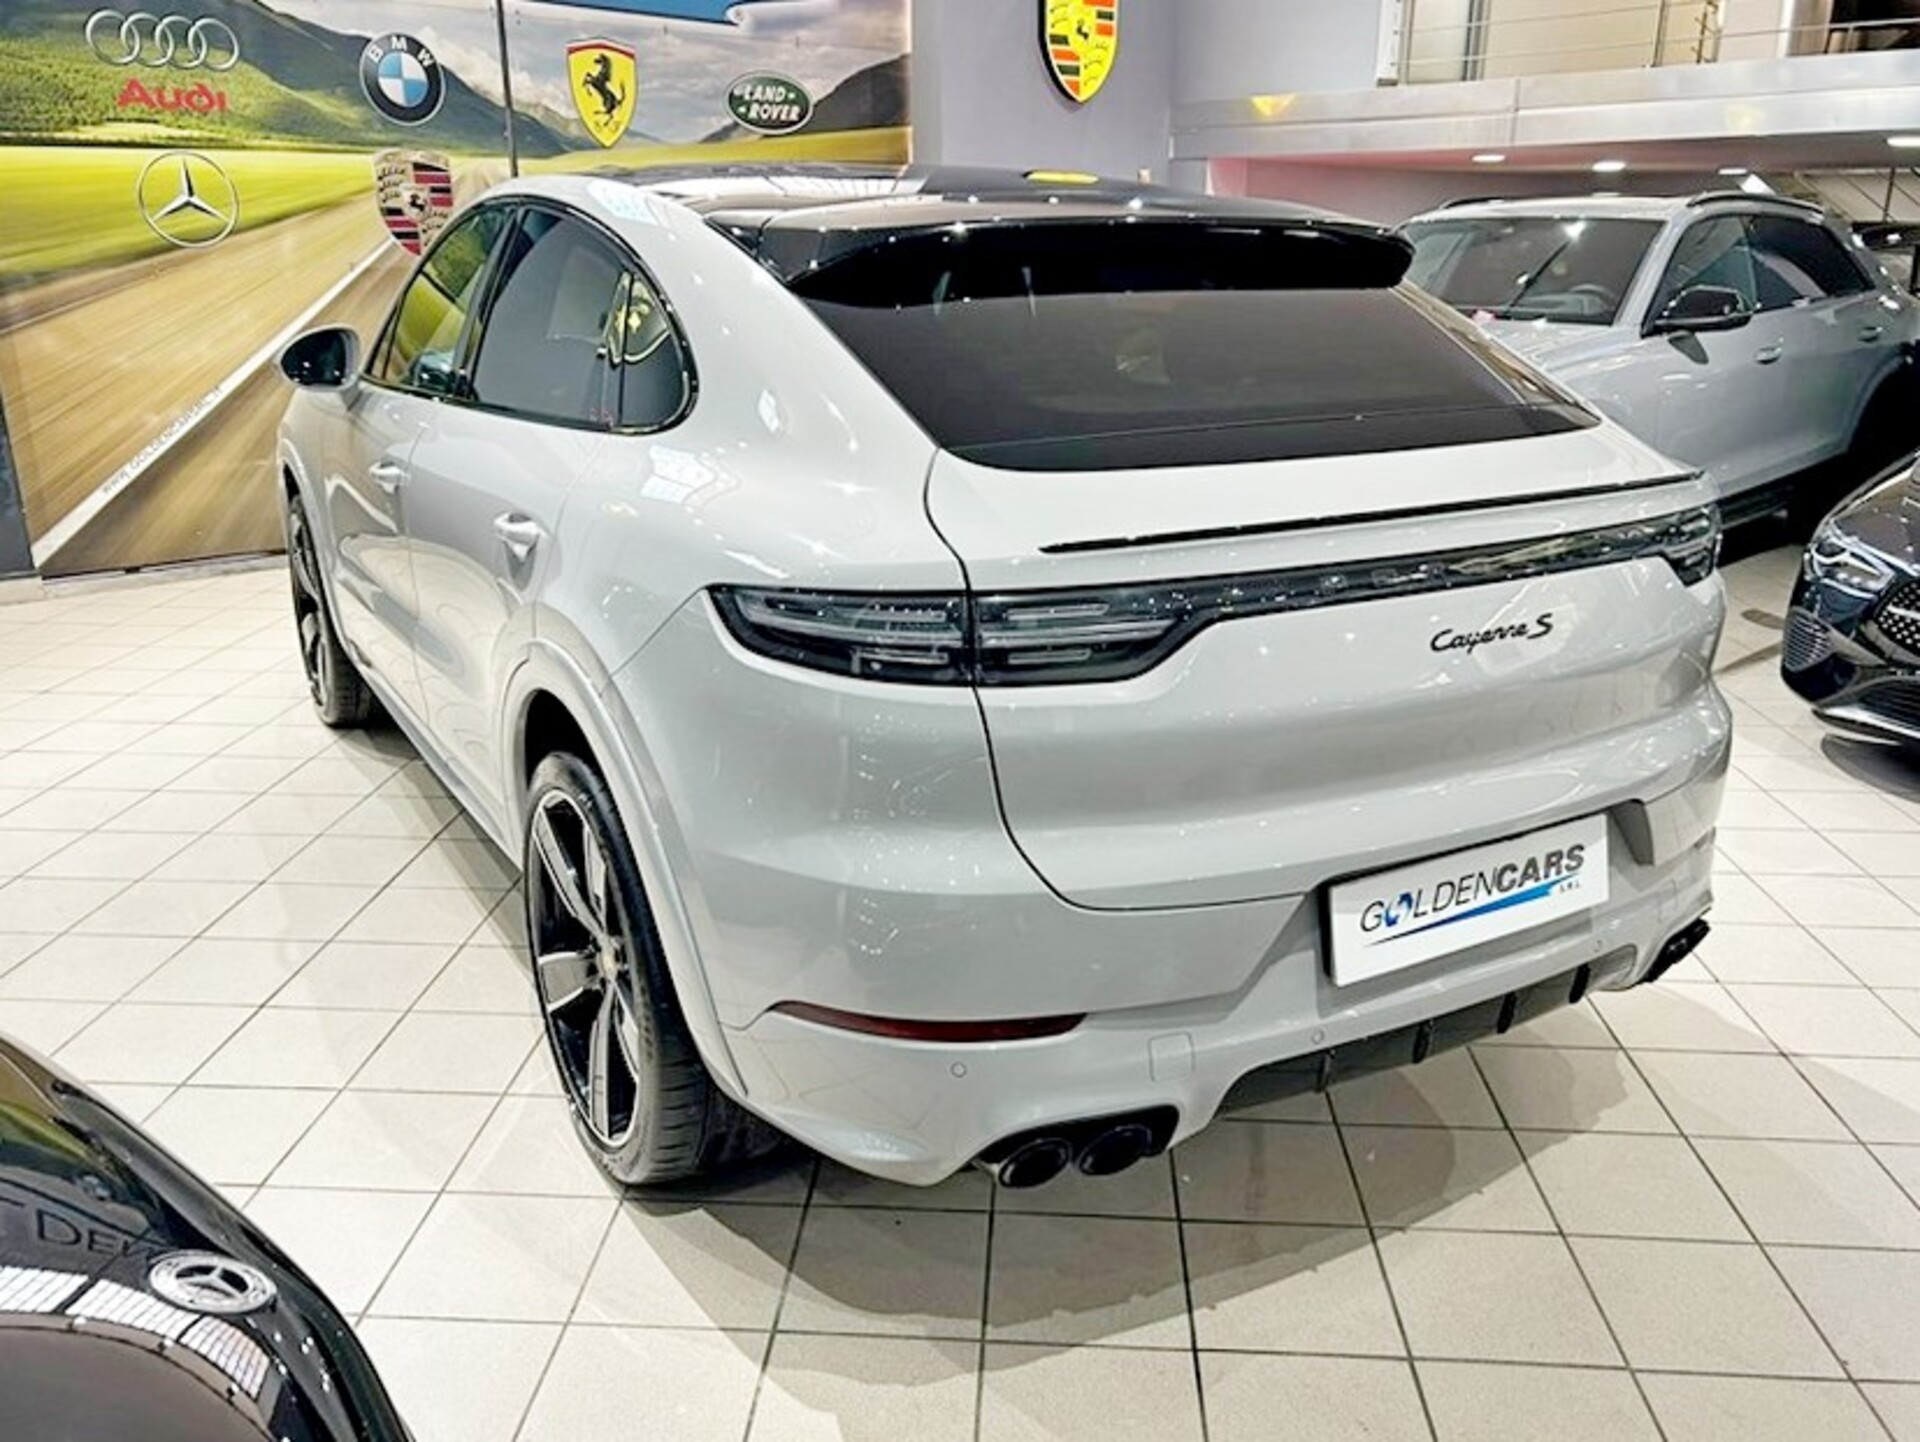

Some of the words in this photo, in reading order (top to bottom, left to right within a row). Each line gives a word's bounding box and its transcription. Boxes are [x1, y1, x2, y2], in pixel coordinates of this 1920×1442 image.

[366, 35, 435, 67] BMW
[117, 77, 229, 112] Audi
[743, 84, 787, 103] LAND
[748, 102, 801, 121] ROVER
[1430, 621, 1528, 655] Cayenne
[1527, 612, 1554, 640] S
